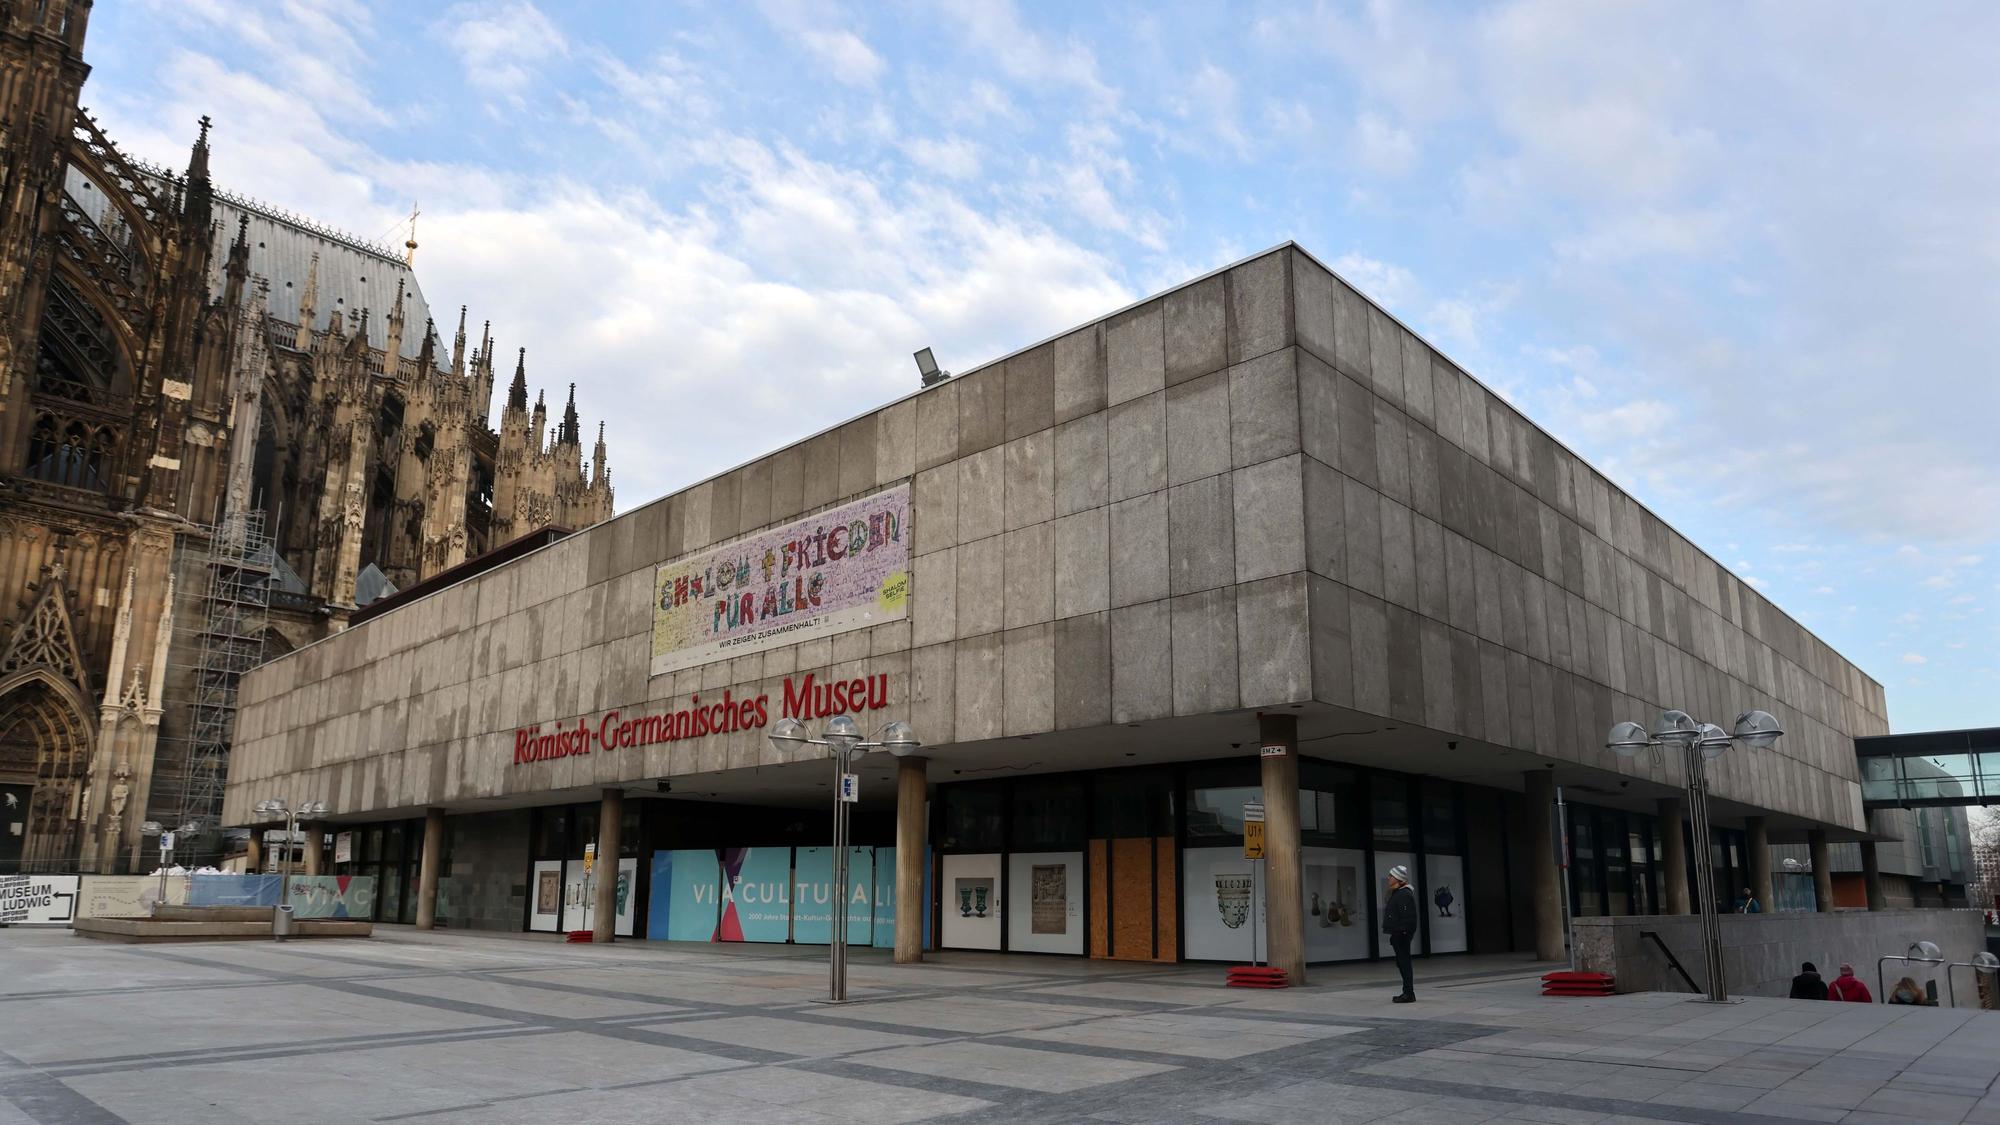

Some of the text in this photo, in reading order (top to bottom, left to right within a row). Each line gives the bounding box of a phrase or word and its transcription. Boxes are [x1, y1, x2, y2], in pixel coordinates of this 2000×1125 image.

[780, 508, 901, 578] FRIEDEN
[713, 572, 826, 632] FÜR ALLE
[718, 618, 821, 649] WIR ZEIGEN ZUSAMMENHALT!
[513, 672, 888, 765] Römisch-Germanisches Museu
[0, 884, 52, 899] MUSEUM
[3, 895, 51, 911] LUDWIG
[693, 883, 897, 906] VIA CULTUALI
[748, 912, 762, 921] 2000
